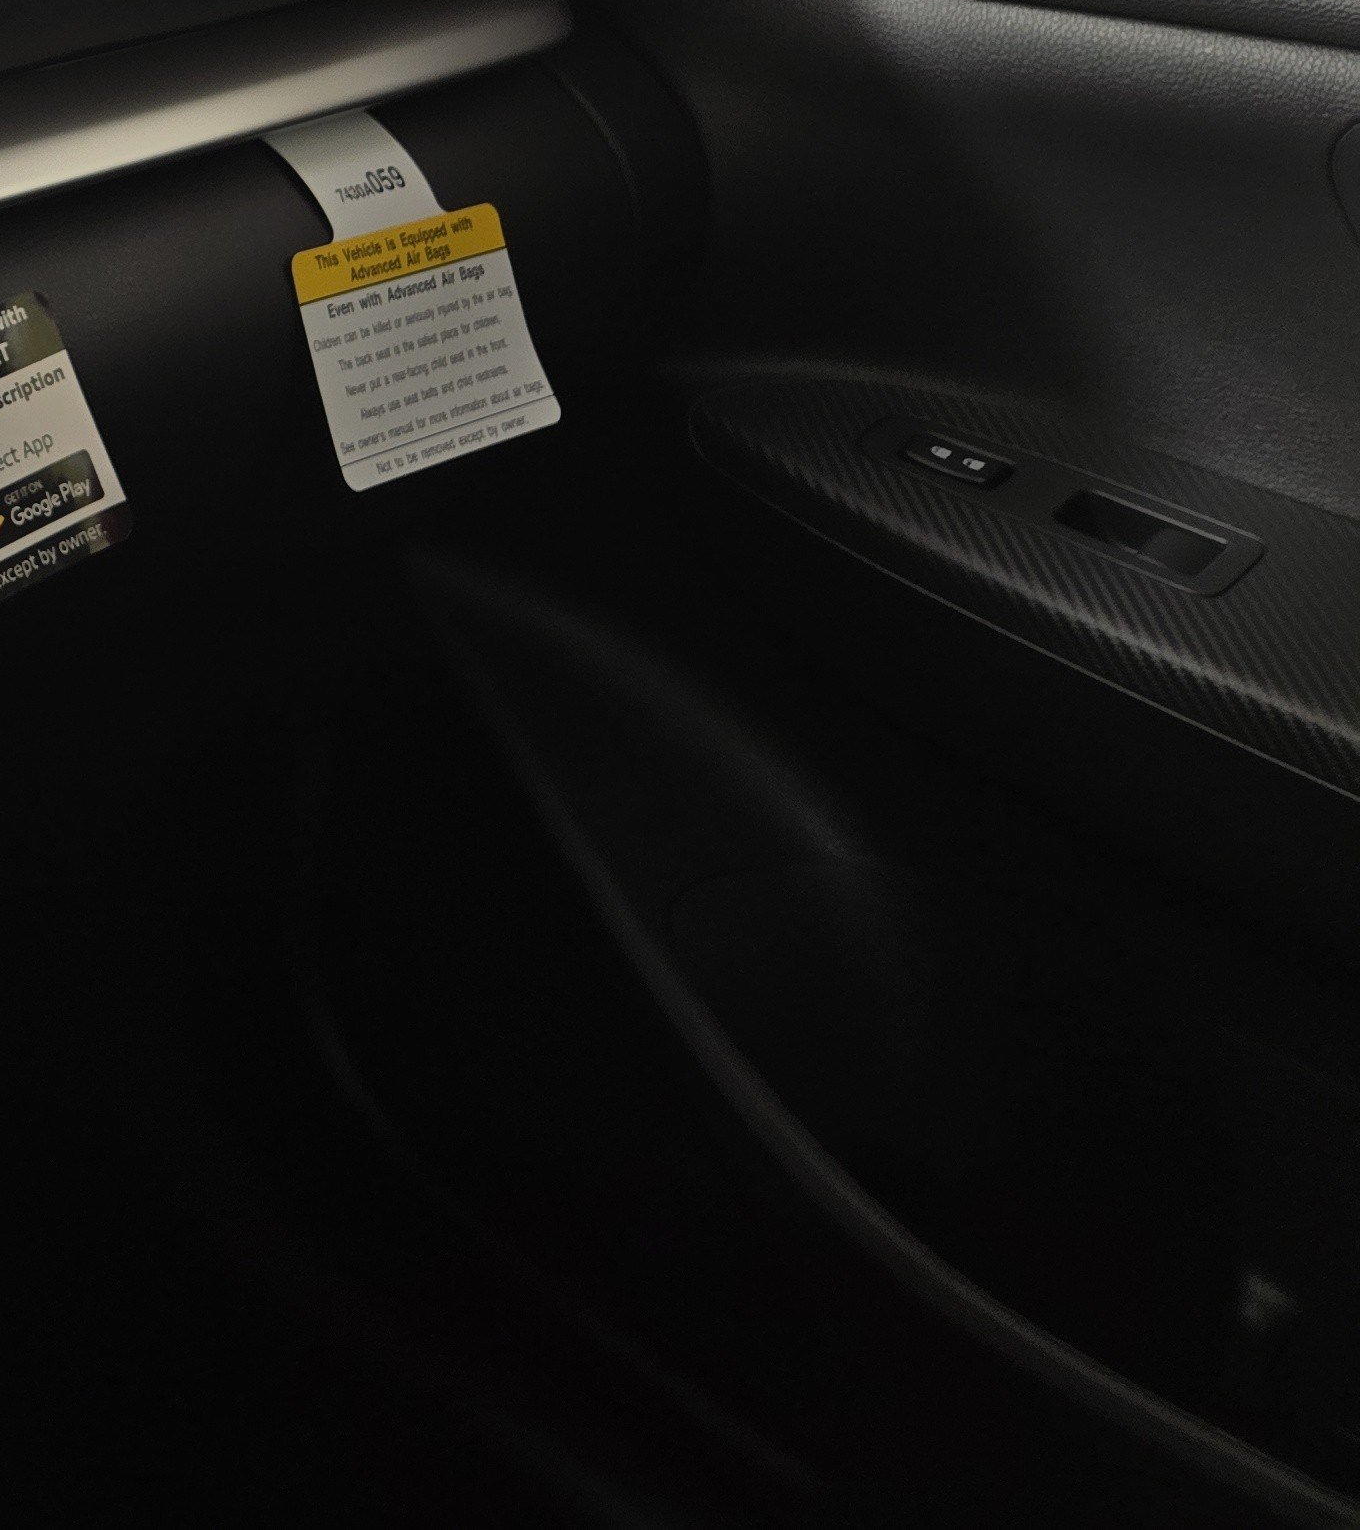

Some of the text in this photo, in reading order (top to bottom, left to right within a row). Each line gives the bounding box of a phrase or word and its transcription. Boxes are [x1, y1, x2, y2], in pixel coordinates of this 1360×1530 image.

[314, 217, 472, 269] This Vehicle is Equipped with
[350, 244, 451, 281] Advanced Air Bags
[326, 264, 484, 318] Even with Advanced Air Bags
[22, 433, 53, 458] App
[10, 478, 90, 525] Google Play
[37, 546, 56, 565] by
[58, 523, 106, 554] owner.
